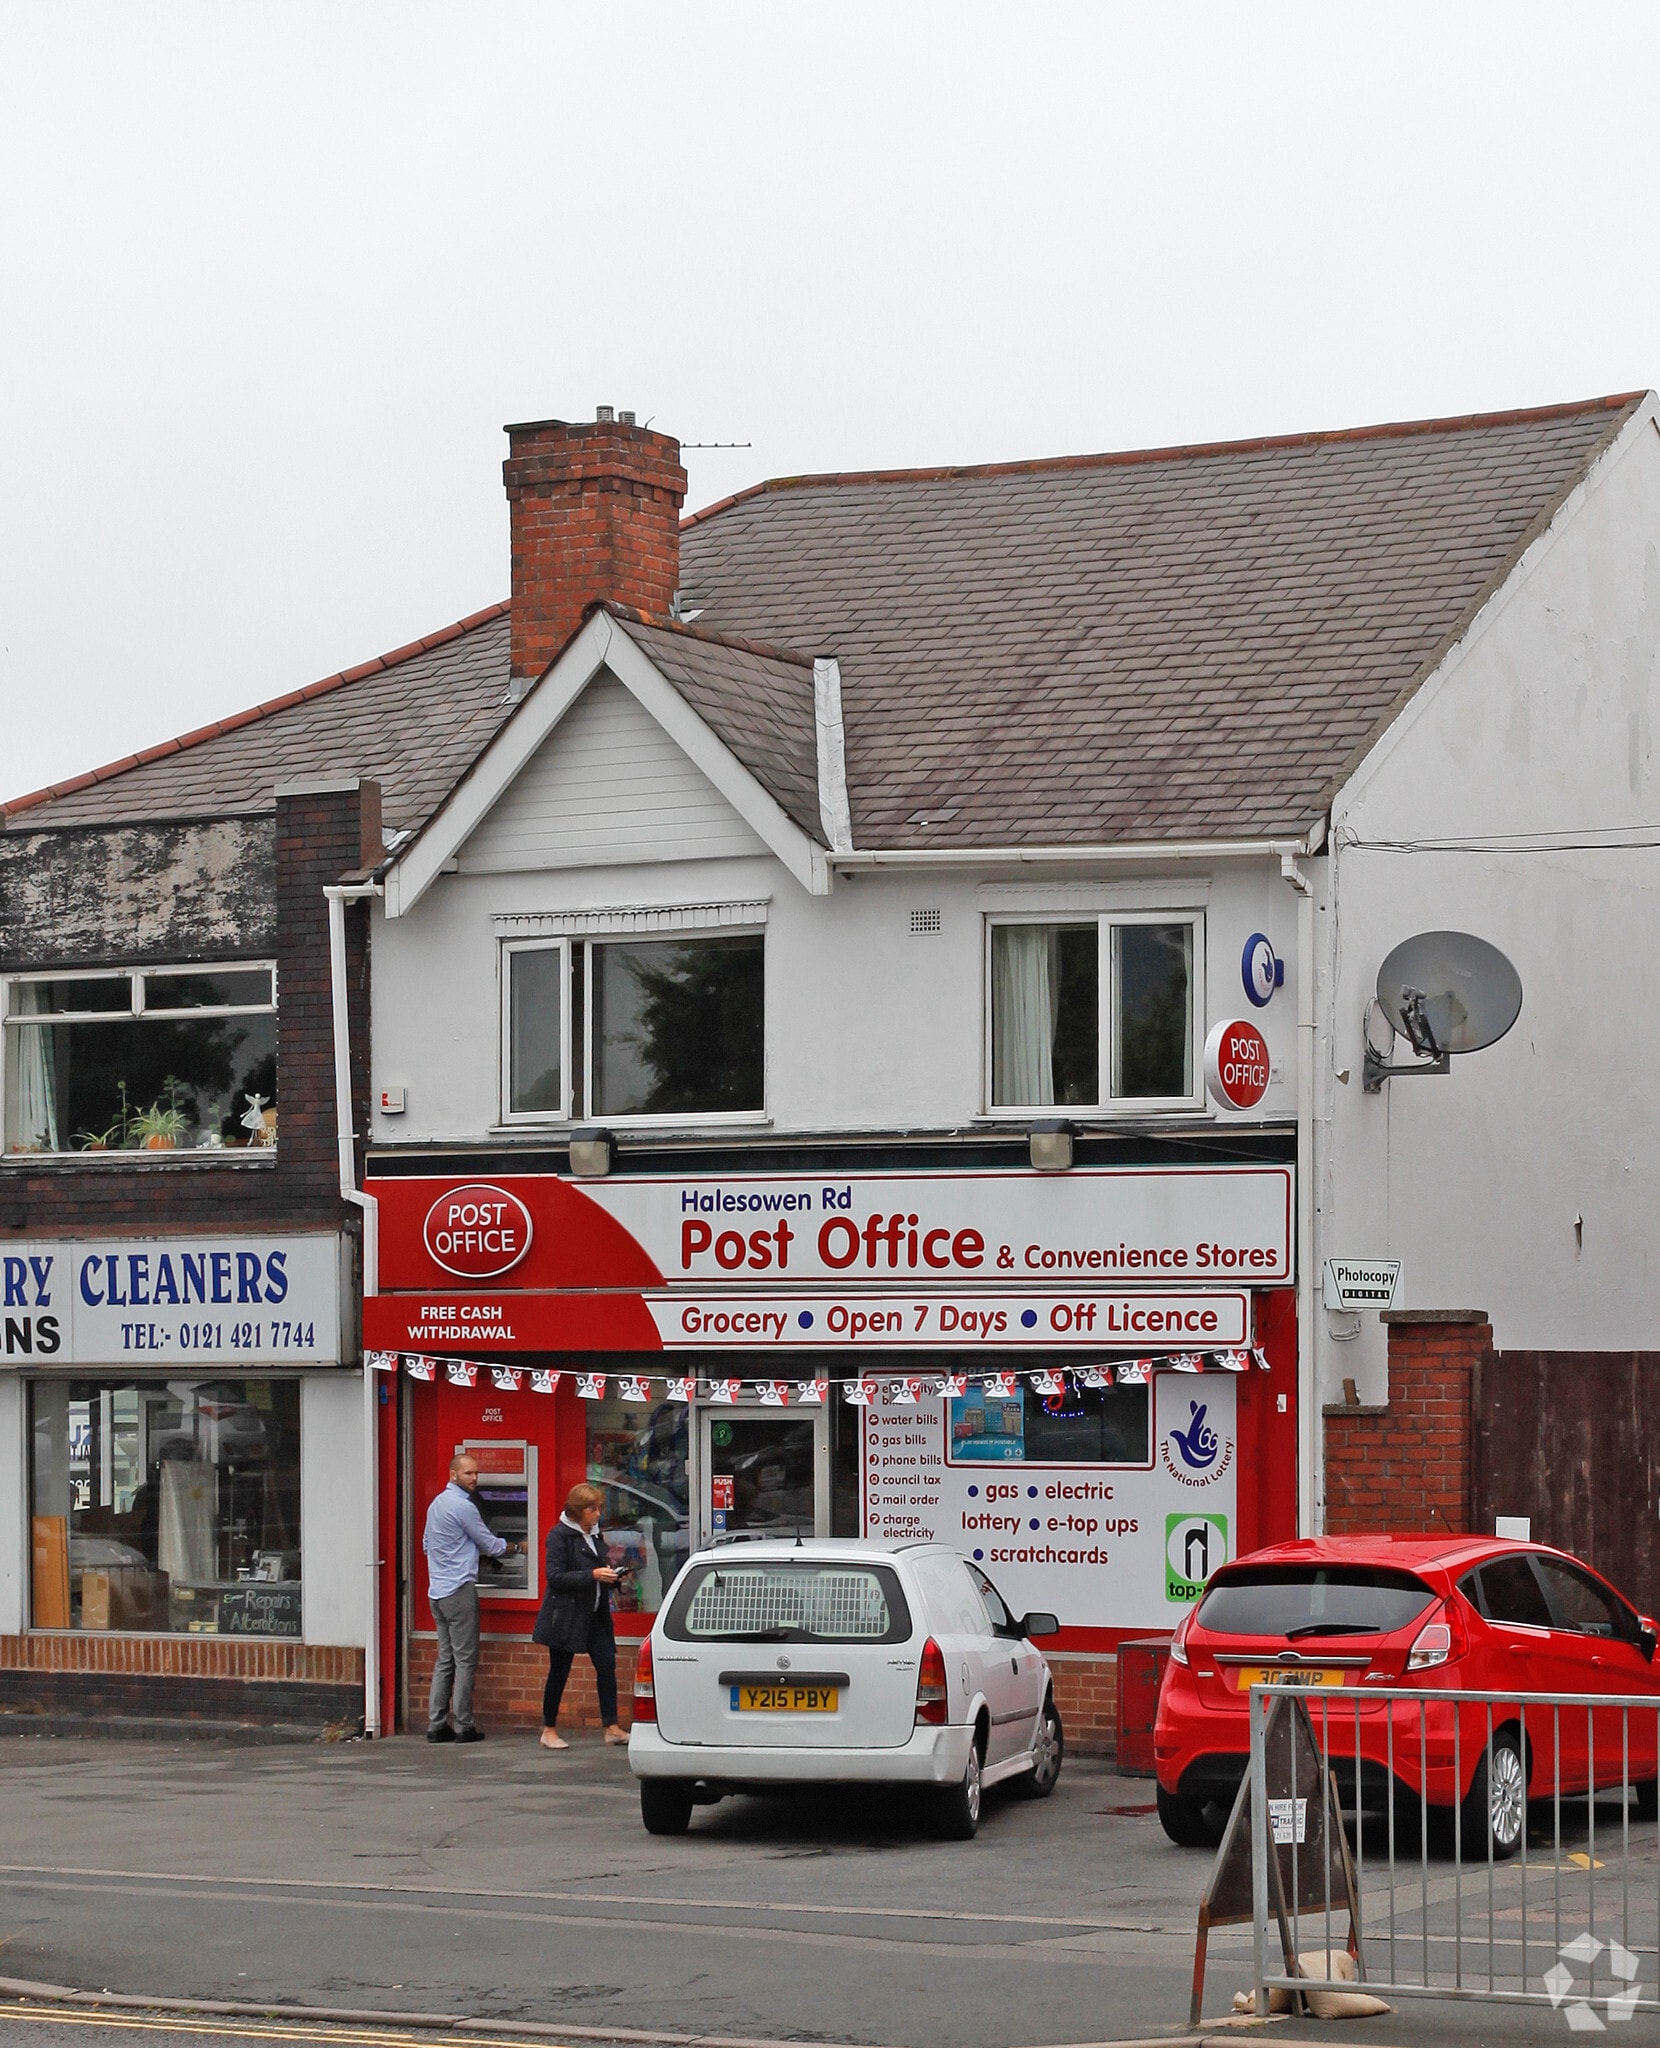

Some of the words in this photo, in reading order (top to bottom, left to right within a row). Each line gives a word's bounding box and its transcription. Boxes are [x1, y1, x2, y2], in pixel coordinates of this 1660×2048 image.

[1230, 1037, 1261, 1060] POST
[1223, 1063, 1265, 1087] OFFICE
[681, 1188, 812, 1213] Halesowen
[821, 1185, 852, 1210] Rd
[448, 1203, 508, 1227] POST
[435, 1229, 516, 1254] OFFICE
[680, 1217, 795, 1271] Post
[818, 1213, 985, 1269] Office
[996, 1245, 1016, 1269] &
[1023, 1243, 1189, 1270] Convenience
[1196, 1241, 1278, 1268] Stores
[2, 1256, 55, 1307] RY
[79, 1250, 289, 1307] CLEANERS
[1337, 1266, 1396, 1286] Photocopy
[1343, 1290, 1389, 1299] DIGITAL
[420, 1306, 457, 1320] FREE
[460, 1306, 502, 1320] CASH
[681, 1307, 788, 1340] Grocery
[826, 1305, 902, 1340] Open
[912, 1305, 929, 1333] 7
[939, 1305, 1008, 1340] Days
[1049, 1302, 1097, 1333] Off
[1106, 1303, 1219, 1333] Licence
[0, 1315, 61, 1354] NS
[121, 1322, 171, 1349] TEL:-
[179, 1322, 222, 1349] 0121
[230, 1321, 262, 1348] 421
[270, 1321, 316, 1348] 7744
[407, 1325, 516, 1340] WITHDRAWAL
[882, 1416, 913, 1425] water
[916, 1414, 939, 1425] bills
[882, 1437, 902, 1448] gas
[905, 1434, 927, 1445] bills
[882, 1454, 917, 1468] phone
[920, 1454, 942, 1465] bills
[1160, 1440, 1171, 1463] The
[1166, 1462, 1211, 1488] National
[1210, 1440, 1235, 1481] Lottery
[882, 1474, 920, 1485] council
[923, 1475, 942, 1485] tax
[882, 1494, 907, 1505] mail
[909, 1494, 940, 1505] order
[985, 1484, 1019, 1503] gas
[1045, 1481, 1114, 1500] electric
[882, 1514, 921, 1527] charge
[961, 1511, 1021, 1535] lottery
[1047, 1514, 1099, 1537] e-top
[1105, 1518, 1139, 1537] ups
[883, 1527, 935, 1540] electricity
[990, 1545, 1109, 1565] scratchcards
[245, 1589, 292, 1617] Repairs
[229, 1611, 298, 1633] Alterations
[746, 1689, 788, 1708] Y215
[794, 1690, 832, 1709] PBY
